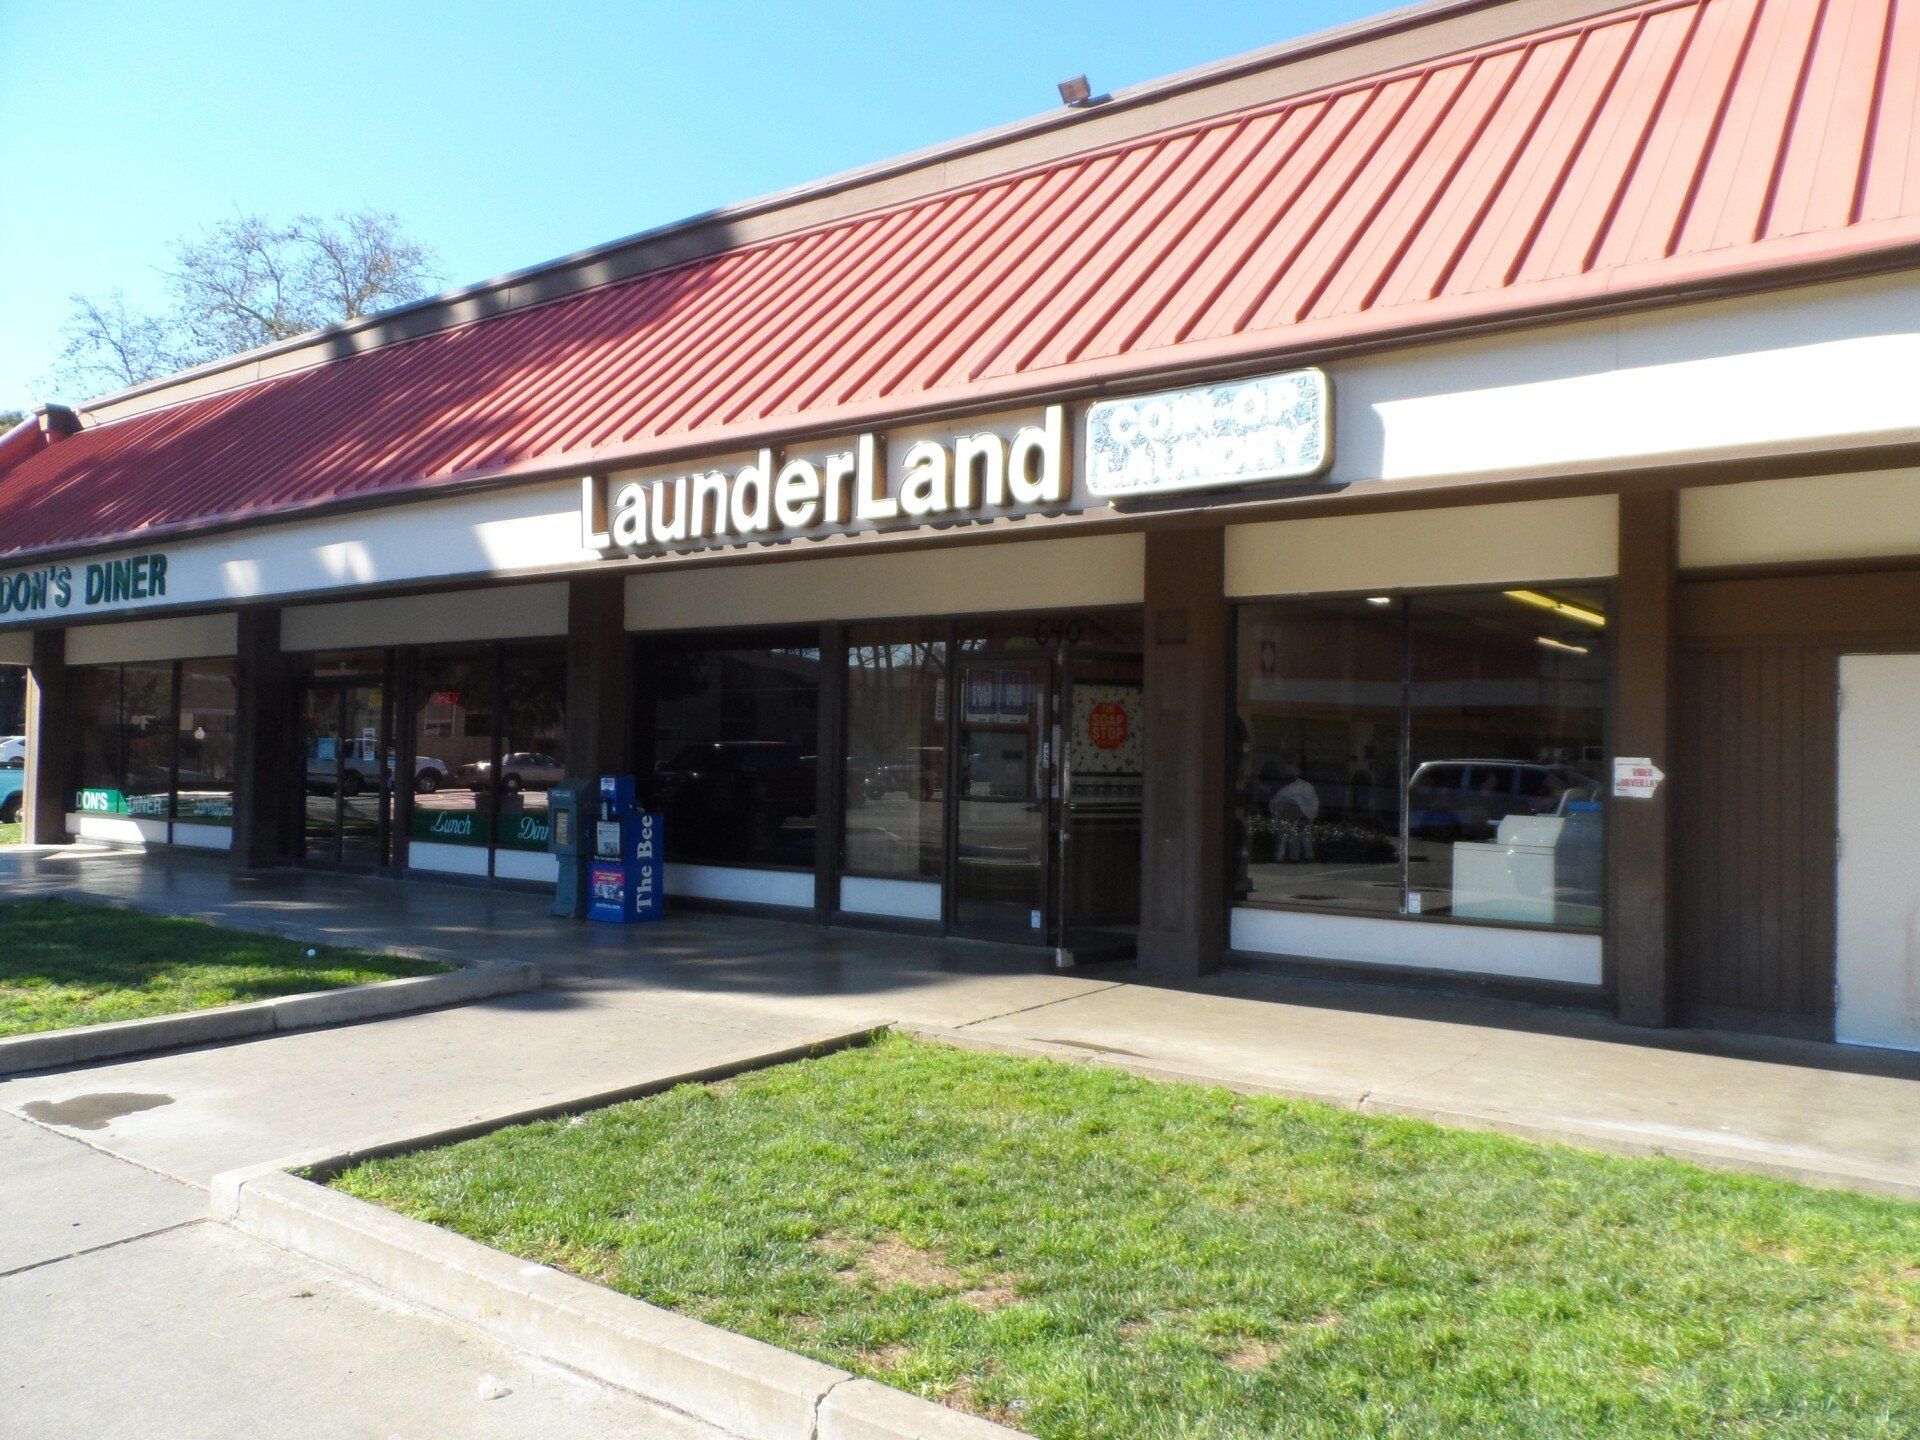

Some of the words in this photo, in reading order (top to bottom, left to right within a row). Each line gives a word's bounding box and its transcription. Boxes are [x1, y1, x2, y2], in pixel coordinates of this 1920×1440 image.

[1110, 382, 1297, 443] COIN-OP
[581, 404, 1064, 550] LaunderLand
[85, 554, 168, 606] DINER
[1093, 713, 1125, 727] SOAP
[1093, 727, 1124, 740] STOP
[75, 790, 108, 811] DON'S
[430, 810, 473, 835] Lunch
[637, 814, 653, 860] Bee
[637, 864, 652, 914] The
